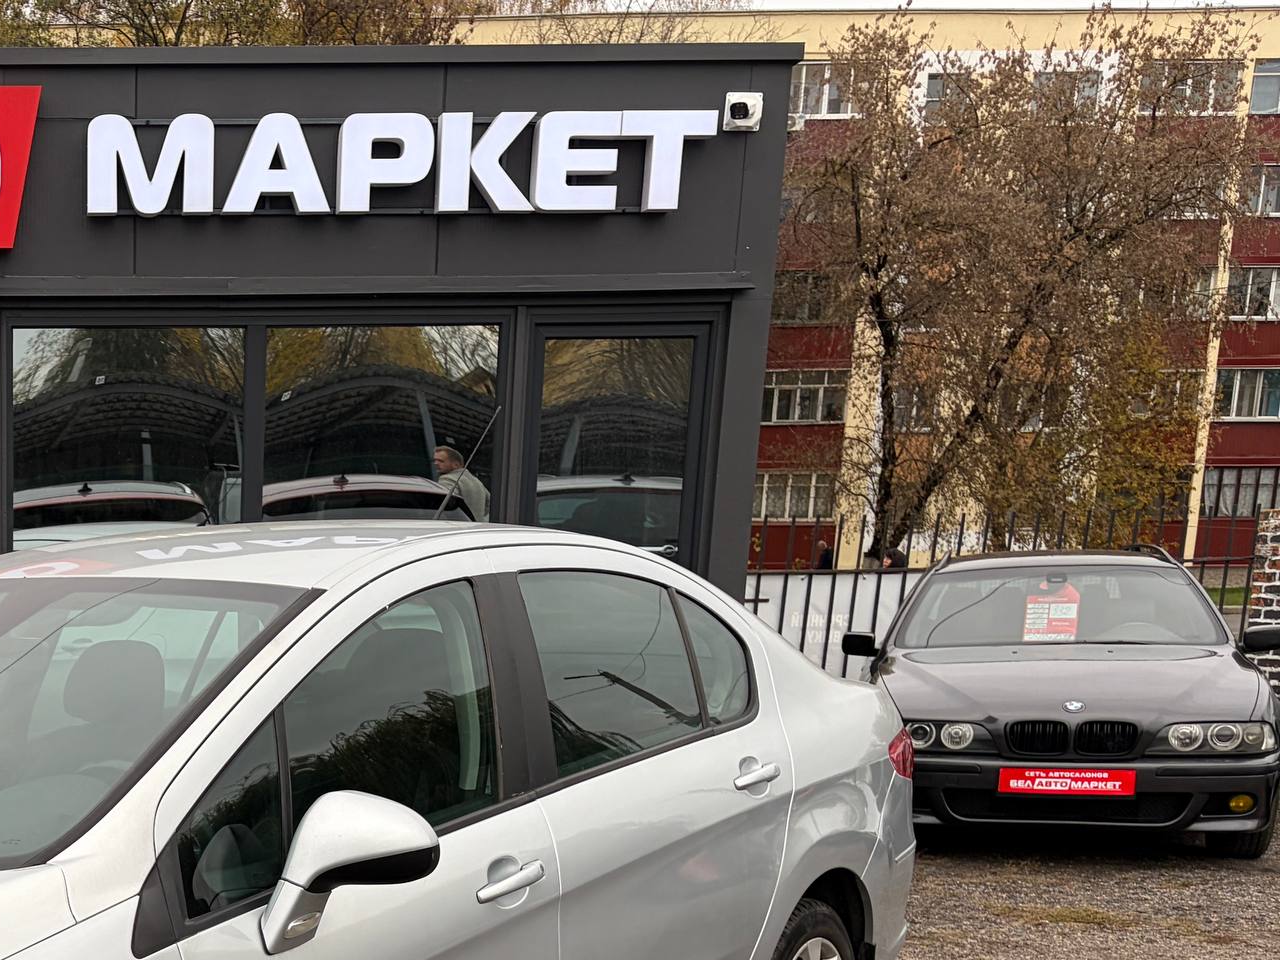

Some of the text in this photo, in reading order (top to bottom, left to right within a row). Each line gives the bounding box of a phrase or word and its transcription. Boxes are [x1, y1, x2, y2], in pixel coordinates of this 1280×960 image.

[87, 109, 719, 215] МАРКЕТ
[1048, 771, 1109, 779] АВТОСАЛОНОВ
[1009, 779, 1122, 790] БЕЛ АВТО МАРКЕТ
